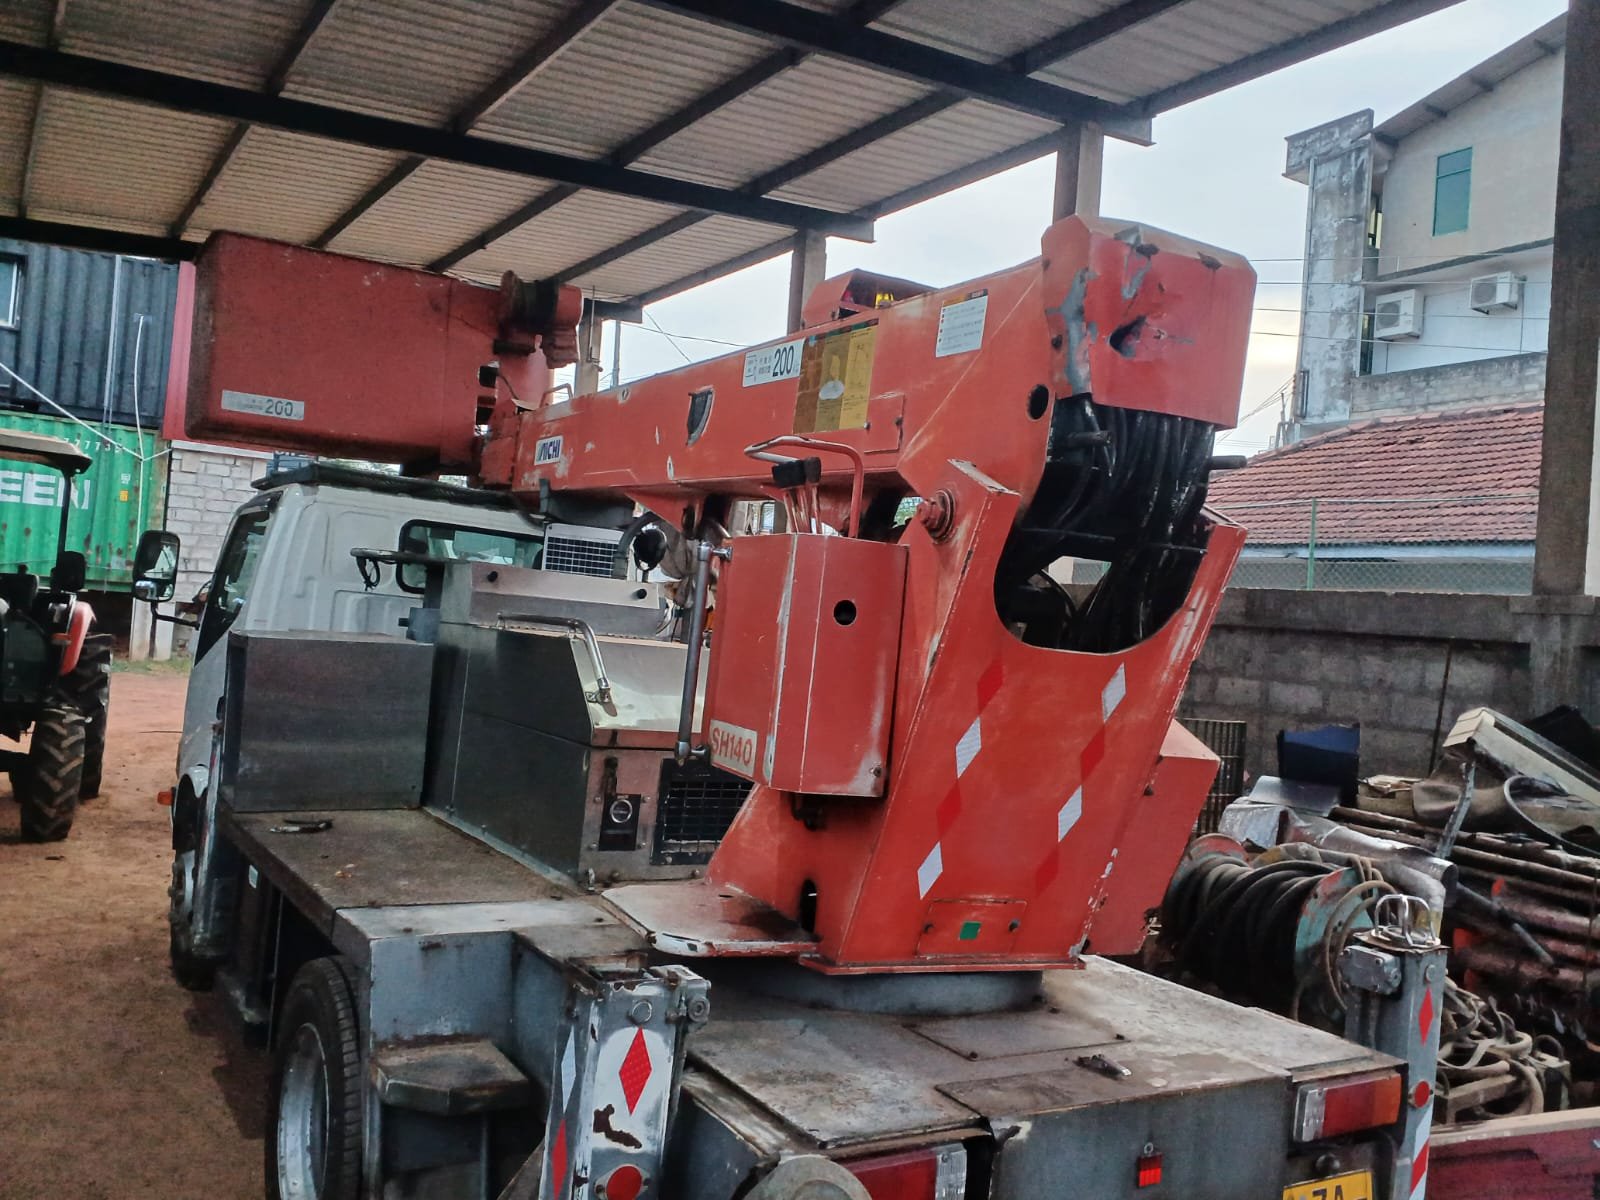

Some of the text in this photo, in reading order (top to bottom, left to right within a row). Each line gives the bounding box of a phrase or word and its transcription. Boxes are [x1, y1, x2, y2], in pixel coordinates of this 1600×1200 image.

[772, 345, 795, 378] 200
[264, 398, 294, 417] 200
[711, 727, 753, 767] SH140
